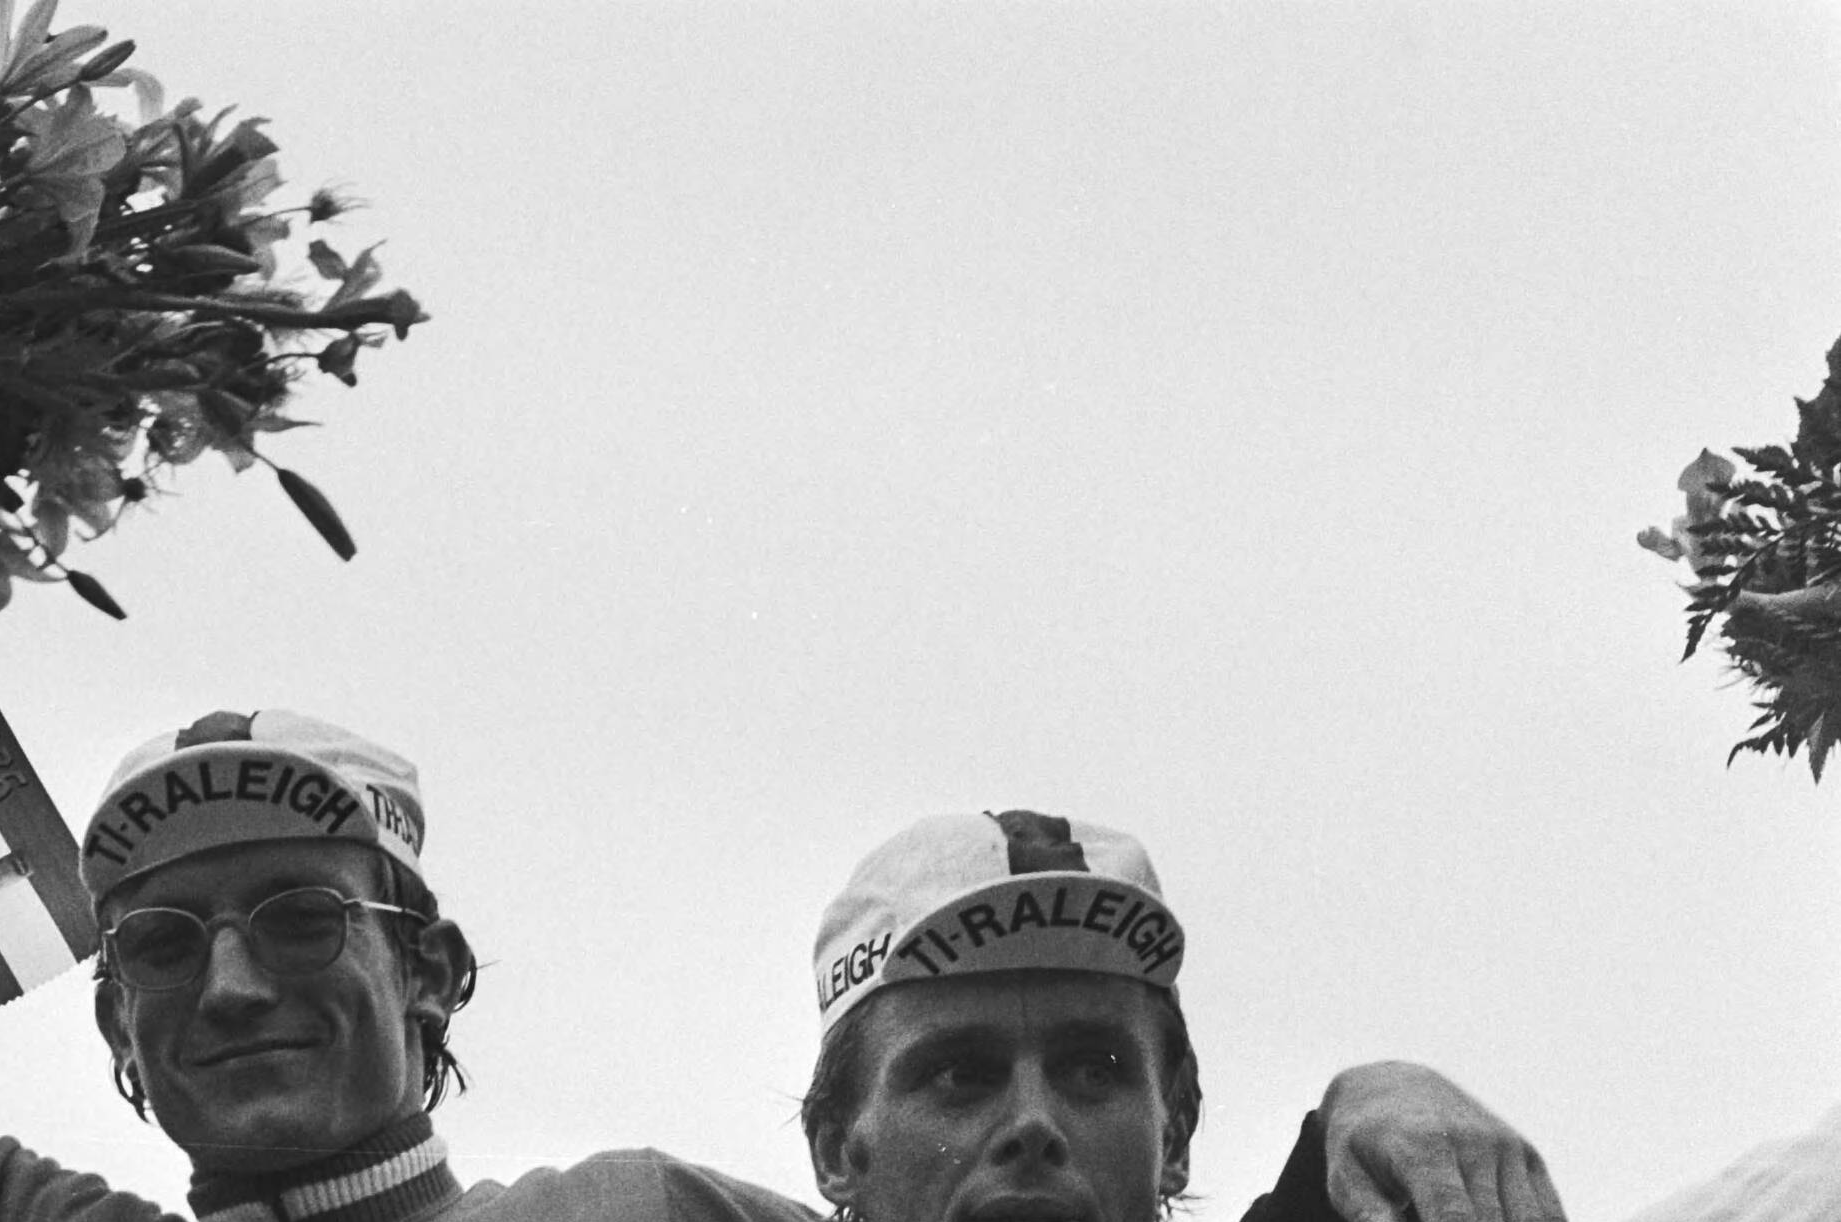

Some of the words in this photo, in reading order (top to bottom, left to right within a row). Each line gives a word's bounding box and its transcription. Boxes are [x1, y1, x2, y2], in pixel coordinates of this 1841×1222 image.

[85, 759, 358, 866] TI-RALEIGH
[817, 932, 893, 1012] LEIGH
[896, 887, 1180, 976] TI-RALEIGH
